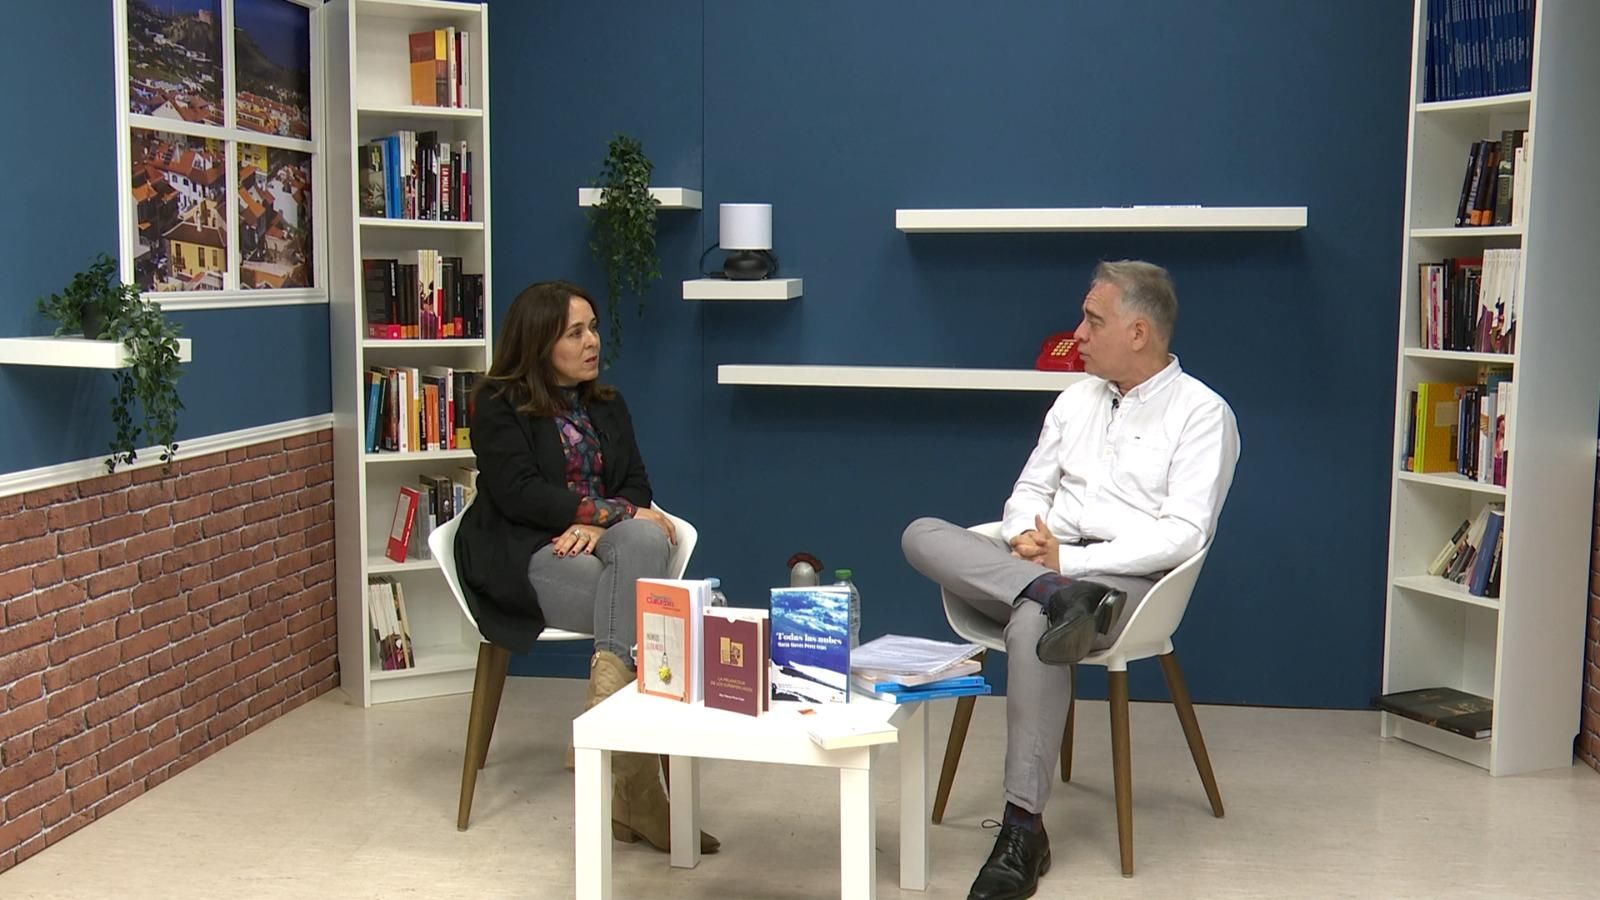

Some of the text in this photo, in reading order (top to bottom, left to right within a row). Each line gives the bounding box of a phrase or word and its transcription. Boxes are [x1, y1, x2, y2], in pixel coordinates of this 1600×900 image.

[441, 176, 450, 192] MALA
[776, 632, 842, 646] Todas las nubes
